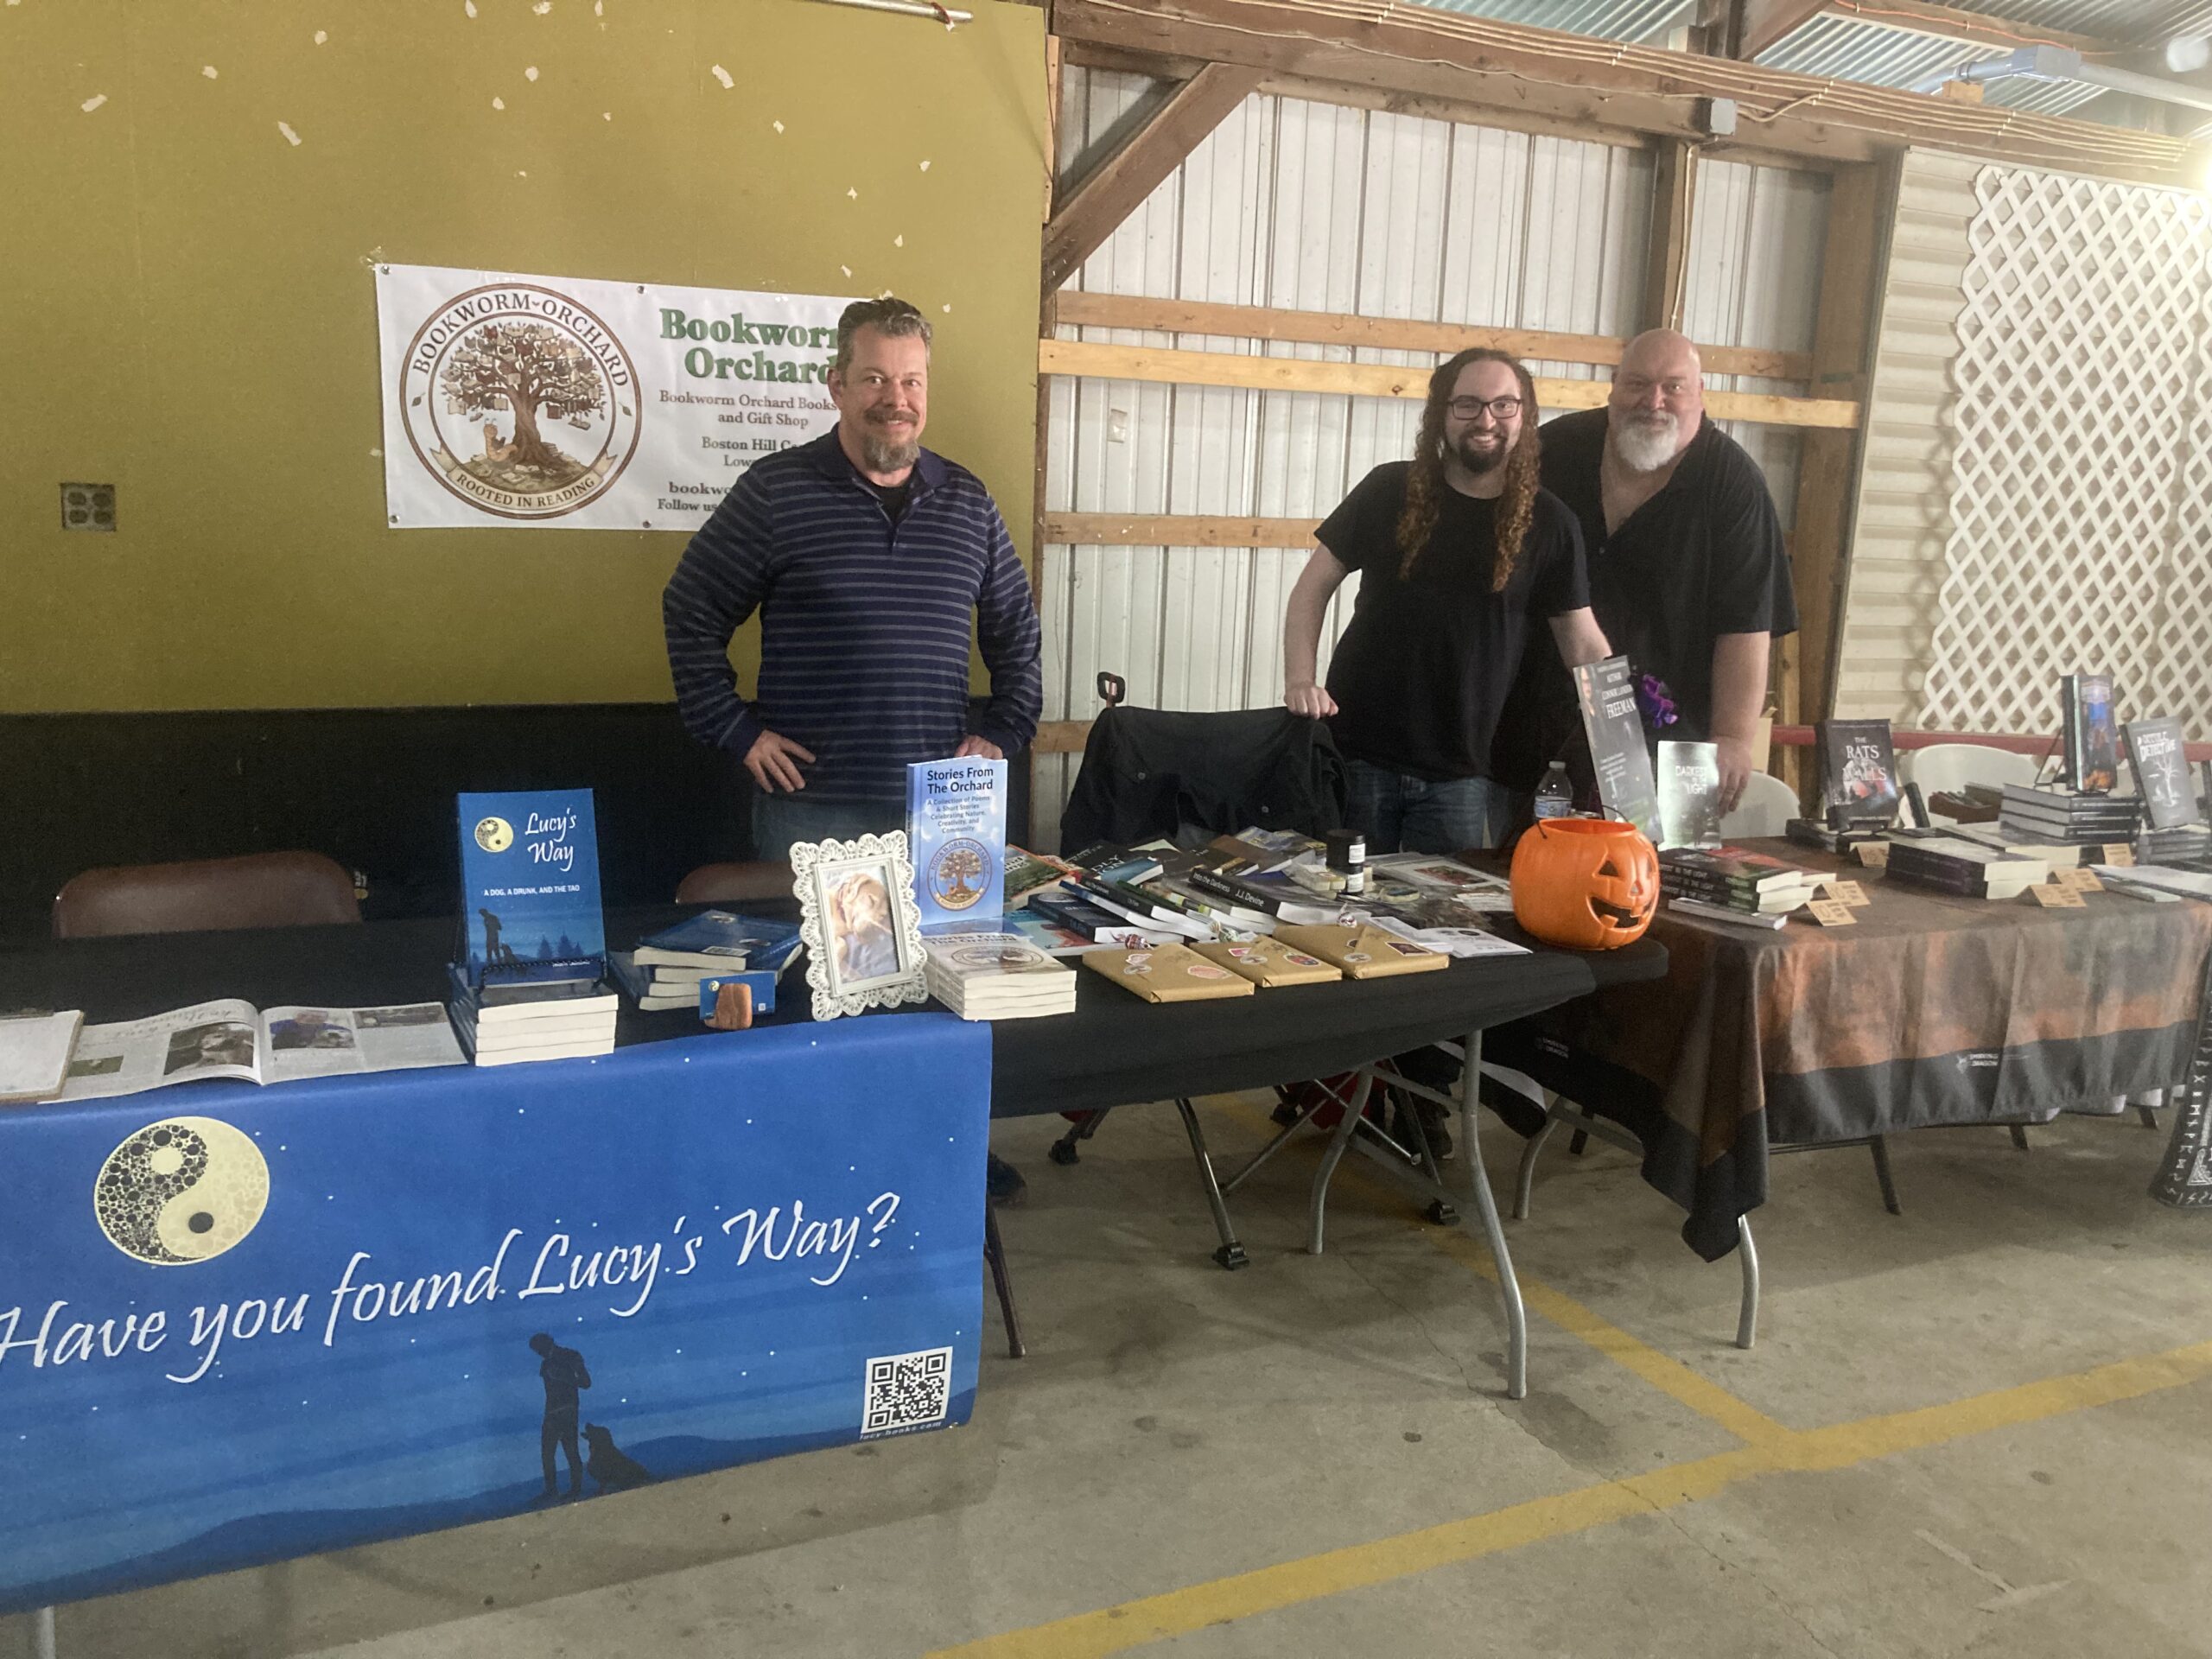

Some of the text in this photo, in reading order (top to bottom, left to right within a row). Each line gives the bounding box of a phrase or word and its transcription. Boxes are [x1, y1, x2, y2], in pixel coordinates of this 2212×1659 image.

[659, 390, 734, 405] Bookworm
[739, 393, 794, 409] Orchard
[718, 411, 809, 429] and Gift Shop
[702, 435, 748, 450] Boston
[752, 438, 777, 451] Hill
[456, 474, 596, 507] ROOTED IN READING
[658, 499, 718, 512] Follow us
[1605, 696, 1637, 720] FREEMAN
[1846, 745, 1880, 760] RATS
[927, 766, 994, 781] Stories From
[927, 779, 994, 795] The Orchard
[933, 797, 963, 806] Collection
[931, 811, 964, 820] Celebrating
[524, 807, 577, 842] Lucy's
[527, 839, 574, 872] Way
[538, 886, 553, 894] AND
[554, 885, 567, 893] THE
[568, 884, 581, 893] TAO
[1192, 872, 1203, 881] Into
[1210, 878, 1231, 893] Darkness
[1244, 892, 1265, 907] Devine
[0, 1192, 900, 1383] Have you found Lucy's Way?
